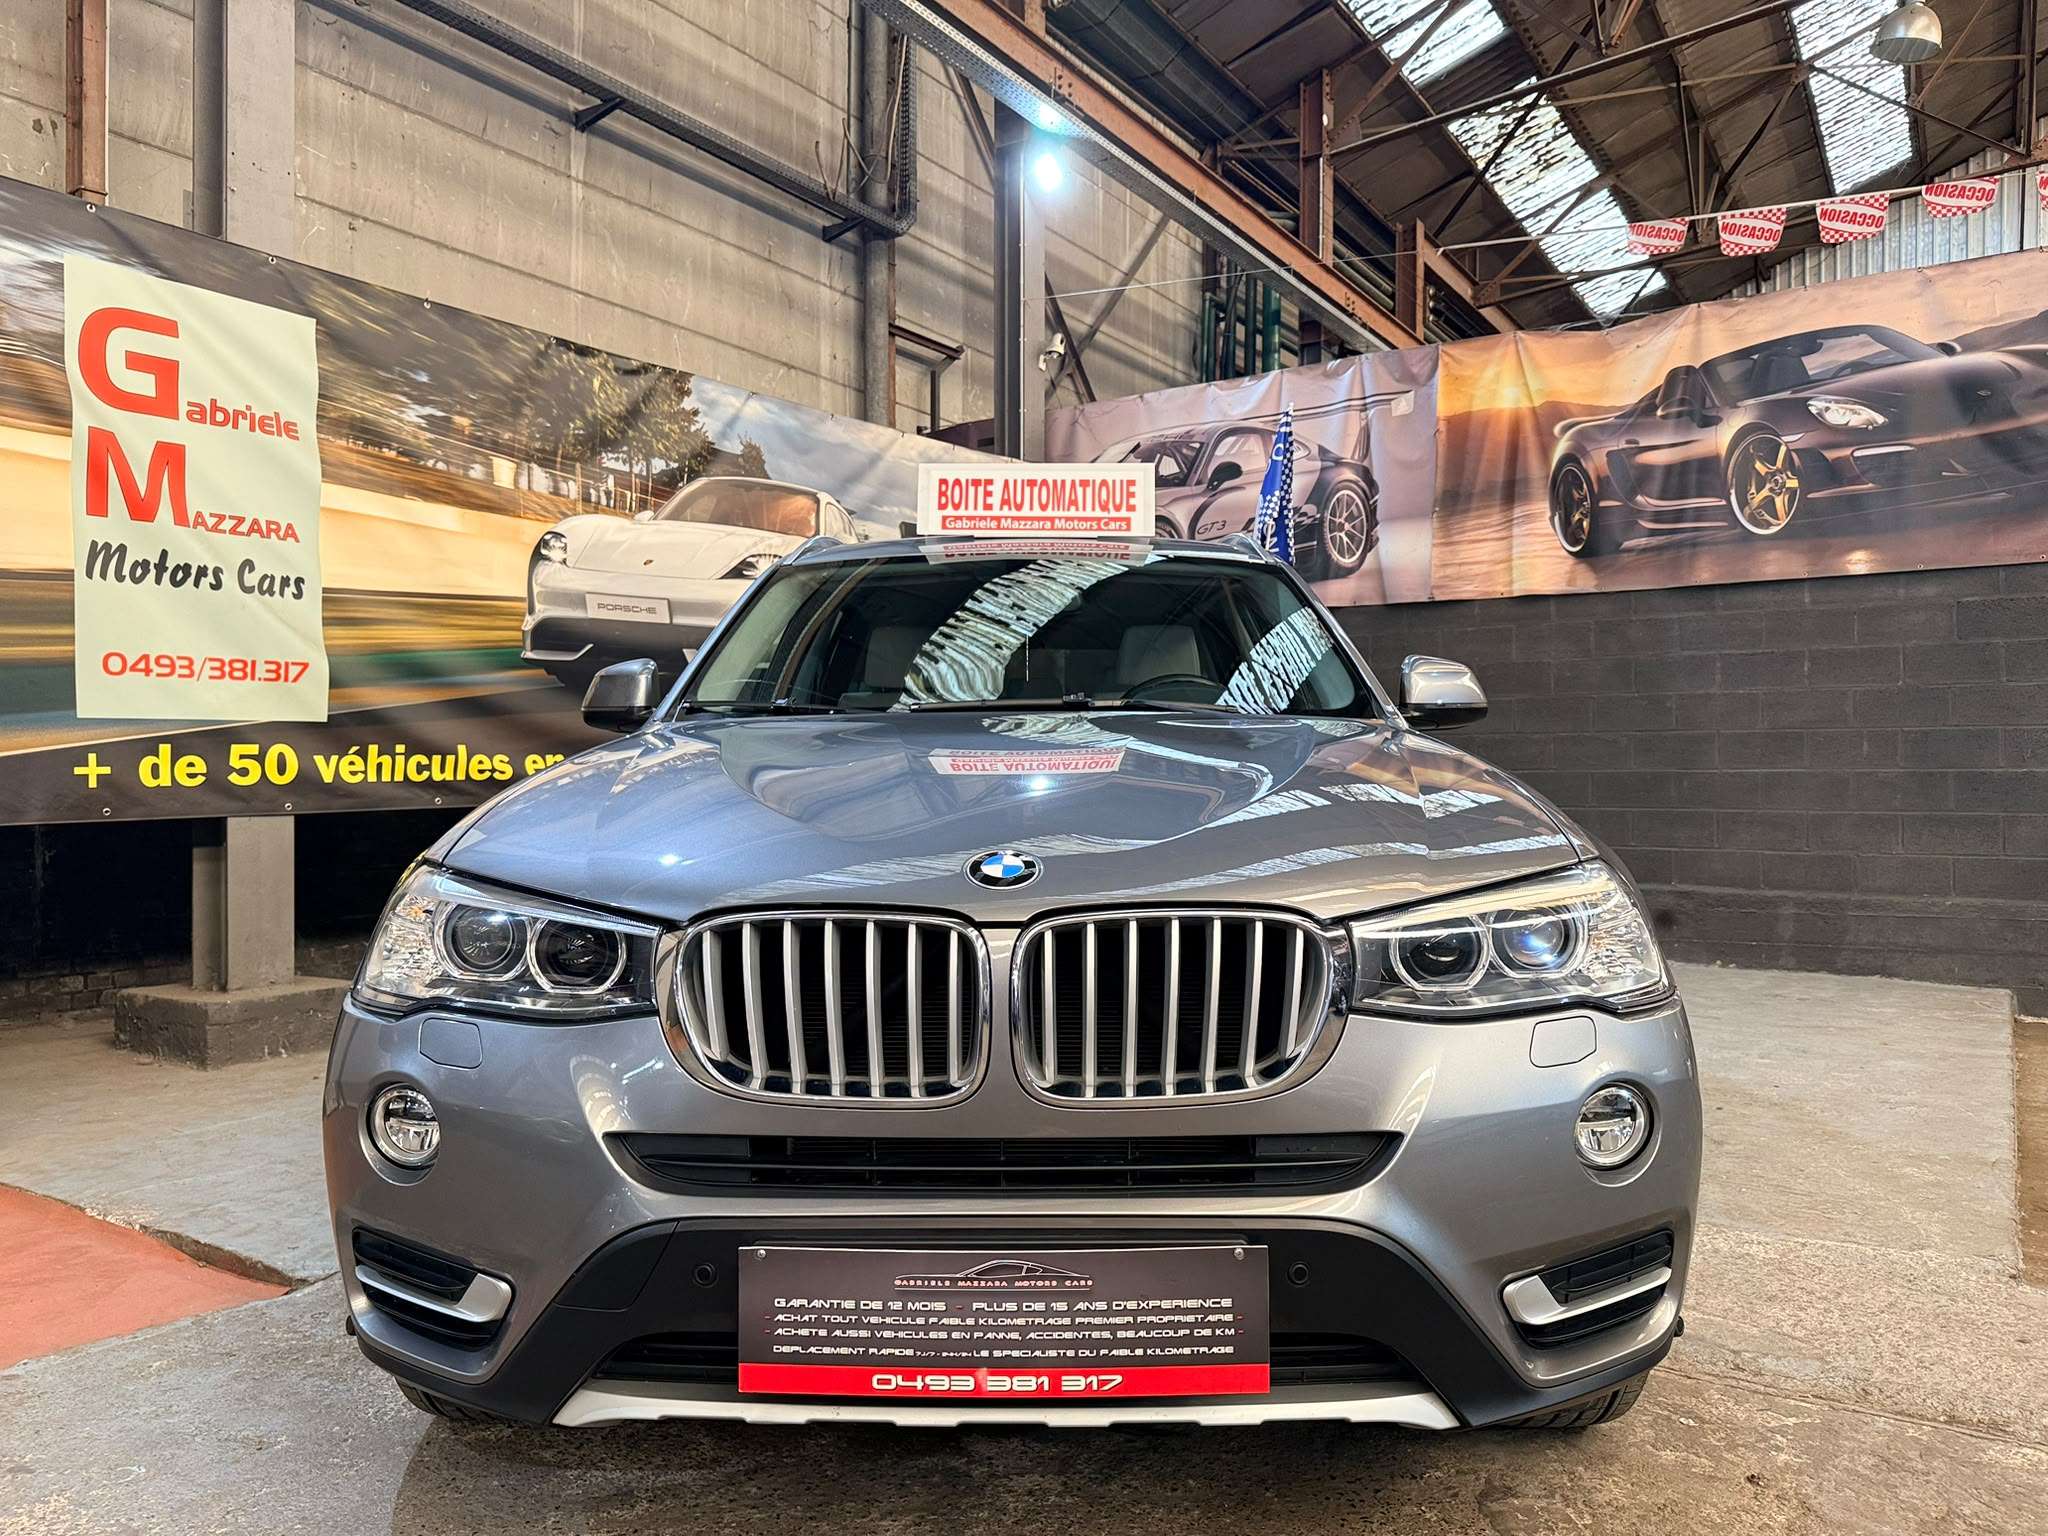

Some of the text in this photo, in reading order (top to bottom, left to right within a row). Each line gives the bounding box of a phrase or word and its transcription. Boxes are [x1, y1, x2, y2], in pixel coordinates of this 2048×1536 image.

[78, 306, 300, 441] Gabriele
[85, 425, 300, 543] MAZZARA
[937, 477, 1137, 514] BOITE AUTOMATIQUE
[945, 516, 1128, 531] Gabriele Mazzara Motors Cars
[1197, 520, 1227, 535] GT3
[85, 539, 306, 600] Motors Cars
[597, 602, 657, 614] PORSCHE
[102, 651, 310, 684] 0493/381.317
[138, 743, 207, 787] de
[227, 743, 298, 786] 50
[312, 744, 513, 783] véhicules
[774, 1298, 856, 1310] GARANTIE
[860, 1300, 883, 1310] DE
[887, 1300, 903, 1311] 12
[907, 1301, 947, 1312] MOIS
[972, 1301, 1018, 1312] PLUS
[1022, 1301, 1047, 1312] DE
[1050, 1301, 1068, 1312] 15
[1072, 1301, 1108, 1311] ANS
[1112, 1298, 1233, 1311] D'EXPERIENCE
[773, 1314, 818, 1323] ACHAT
[821, 1314, 858, 1324] TOUT
[861, 1316, 926, 1325] VEHICULE
[928, 1317, 976, 1326] FAIBLE
[978, 1316, 1072, 1326] KILOMETRAGE
[1075, 1314, 1134, 1325] PREMIER
[1137, 1313, 1234, 1324] PROPRIETAIRE
[773, 1328, 828, 1337] ACHETE
[831, 1329, 871, 1338] AUSSI
[875, 1330, 949, 1340] VEHICULES
[951, 1331, 971, 1340] EN
[973, 1330, 1022, 1341] PANNE,
[1025, 1329, 1114, 1341] ACCIDENTES,
[1116, 1328, 1190, 1338] BEAUCOUP
[1193, 1328, 1213, 1337] DE
[1215, 1327, 1236, 1336] KM
[773, 1345, 866, 1356] DEPLACEMENT
[868, 1347, 915, 1357] RAPIDE
[973, 1349, 990, 1358] LE
[992, 1348, 1075, 1358] SPECIALISTE
[1078, 1348, 1097, 1358] DU
[1099, 1347, 1144, 1357] FAIBLE
[1146, 1345, 1235, 1356] KILOMETRAGE
[871, 1374, 1124, 1392] 0493 381 317
